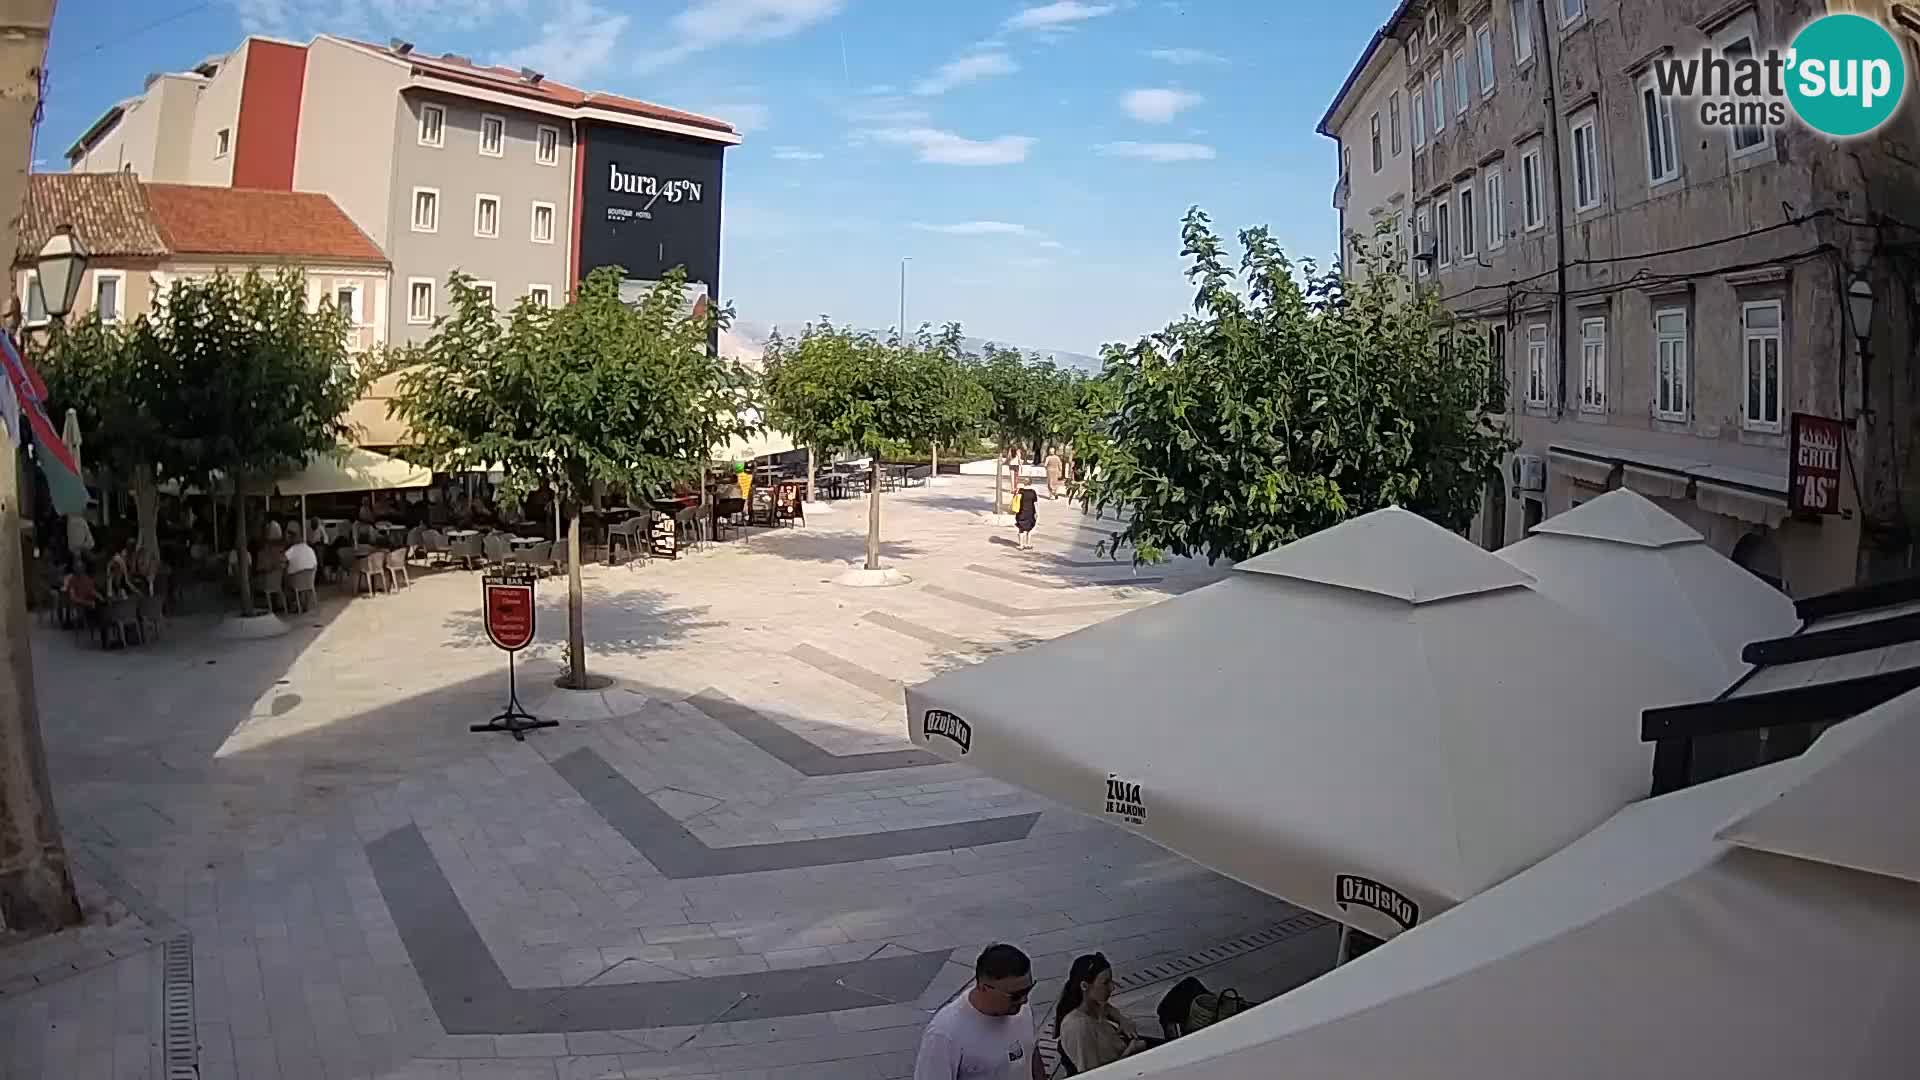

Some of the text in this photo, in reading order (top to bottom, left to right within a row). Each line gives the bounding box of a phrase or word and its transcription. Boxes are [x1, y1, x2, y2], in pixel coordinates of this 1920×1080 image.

[610, 164, 657, 195] bura
[927, 712, 968, 744] Ožujsko
[1342, 877, 1413, 924] Ožujsko
